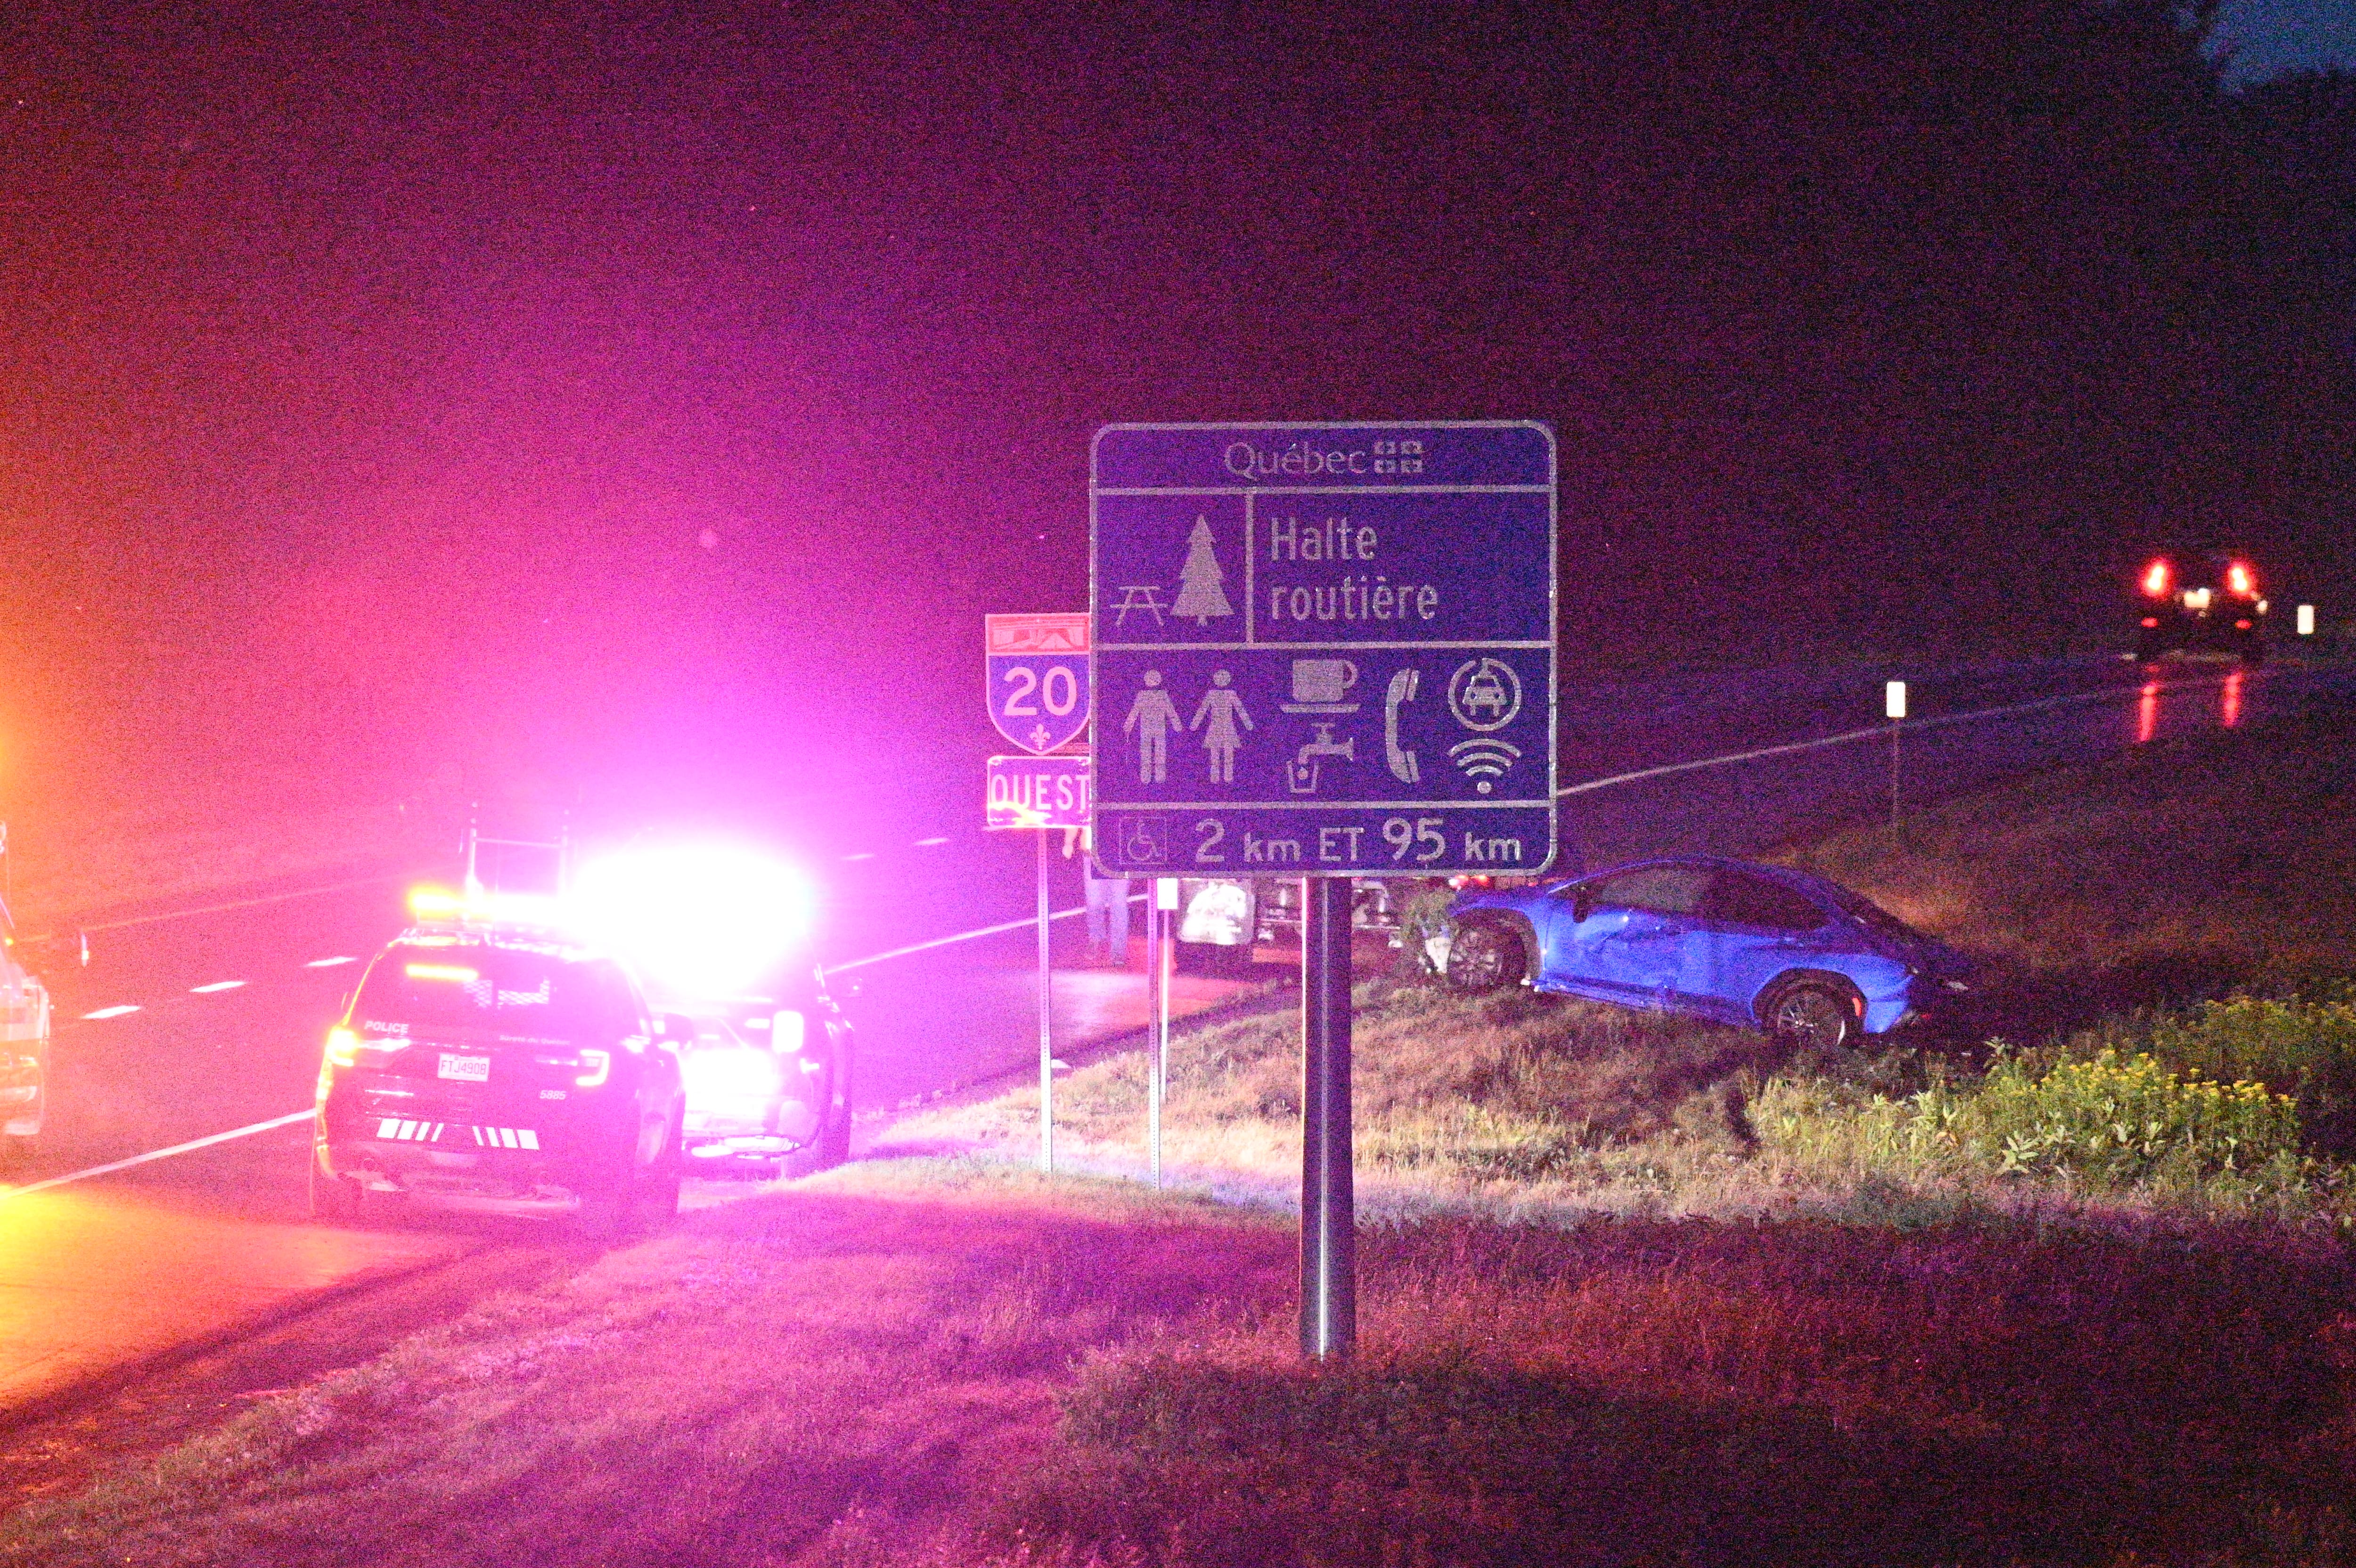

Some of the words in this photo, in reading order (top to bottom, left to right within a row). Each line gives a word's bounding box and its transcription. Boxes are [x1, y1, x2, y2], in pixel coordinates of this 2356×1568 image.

[1225, 442, 1367, 480] Québec
[1270, 518, 1377, 561] Halte
[1271, 576, 1439, 621] routière
[1004, 666, 1077, 716] 20
[990, 774, 1090, 810] OUEST
[1195, 818, 1225, 863] 2
[1243, 832, 1301, 862] km
[1319, 827, 1364, 861] ET
[1382, 817, 1445, 861] 95
[1464, 831, 1522, 861] km
[364, 1021, 409, 1033] POLICE
[441, 1060, 487, 1075] FTJ4908
[539, 1090, 566, 1100] 5885
